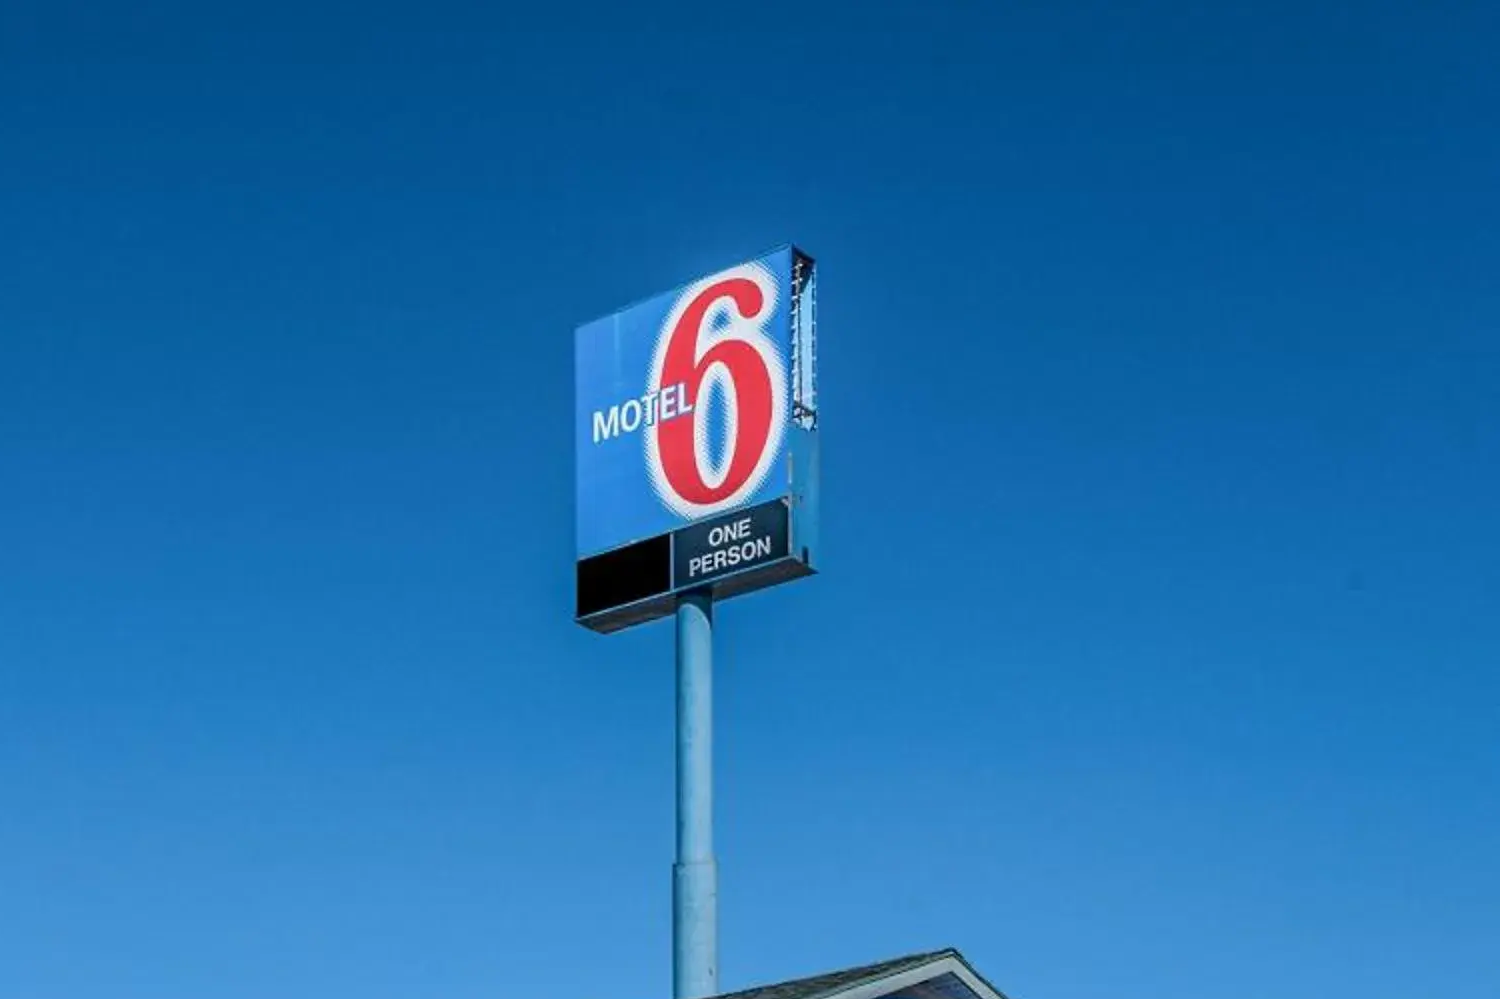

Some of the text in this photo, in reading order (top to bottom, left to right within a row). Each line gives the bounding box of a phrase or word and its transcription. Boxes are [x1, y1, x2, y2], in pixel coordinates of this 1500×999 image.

[592, 275, 776, 508] MOTEL 6
[708, 517, 752, 548] ONE
[688, 536, 772, 578] PERSON
